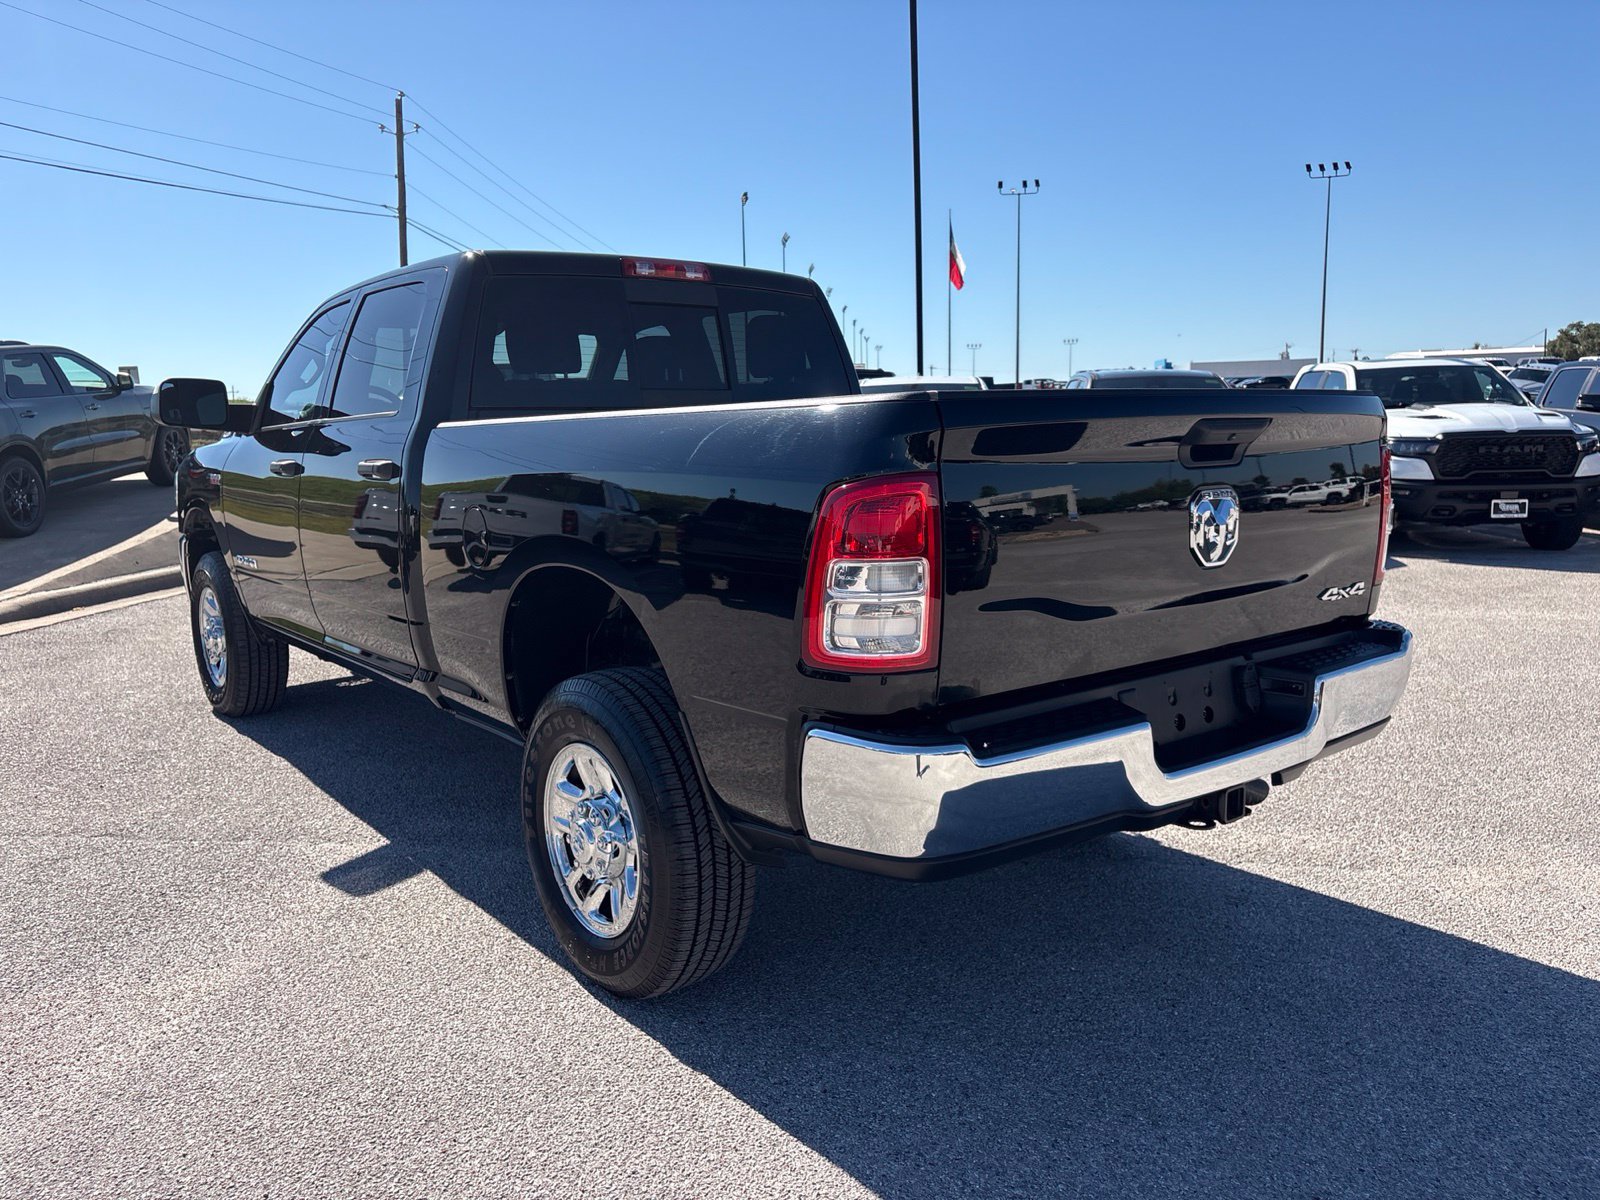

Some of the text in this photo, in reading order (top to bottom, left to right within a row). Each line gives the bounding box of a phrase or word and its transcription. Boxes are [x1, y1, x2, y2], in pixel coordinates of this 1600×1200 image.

[1478, 444, 1544, 453] RAM
[1202, 489, 1233, 500] RAM
[613, 834, 650, 971] TRANSFORCE
